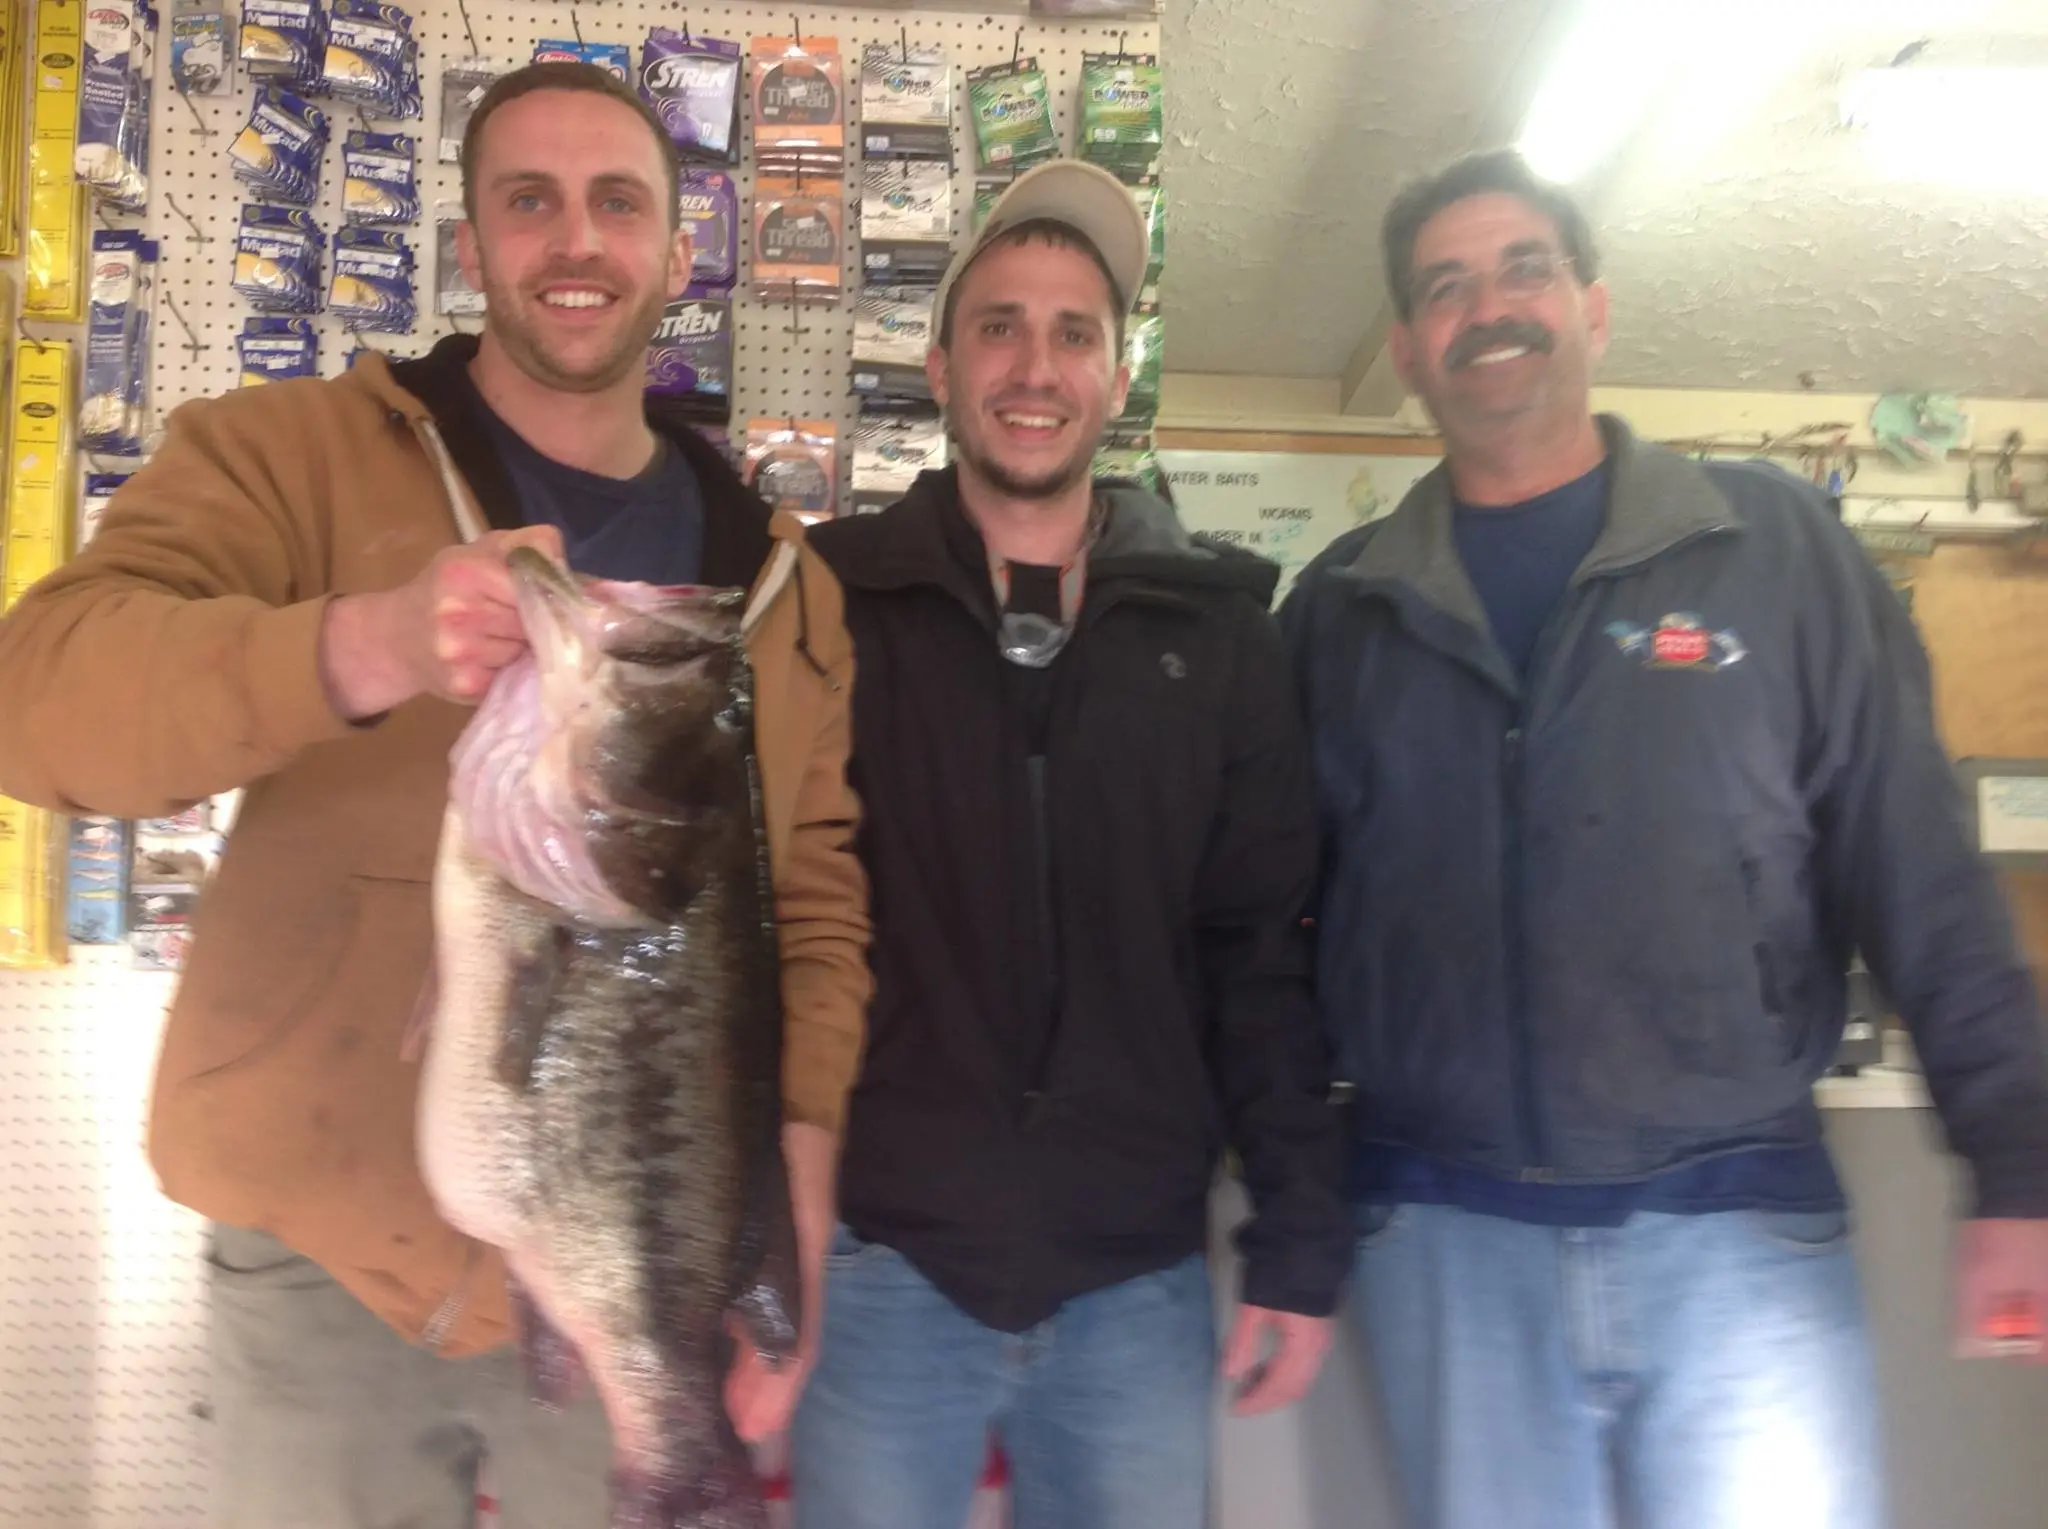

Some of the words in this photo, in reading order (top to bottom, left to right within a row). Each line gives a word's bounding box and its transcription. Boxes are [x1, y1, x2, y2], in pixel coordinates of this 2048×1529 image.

[246, 12, 307, 29] Mtad
[651, 60, 731, 89] STREN
[348, 164, 408, 184] Musad
[679, 195, 715, 210] REN
[337, 261, 397, 280] Muad
[651, 311, 723, 340] TREN
[1216, 471, 1260, 487] BAITS
[1258, 506, 1313, 521] WORMS
